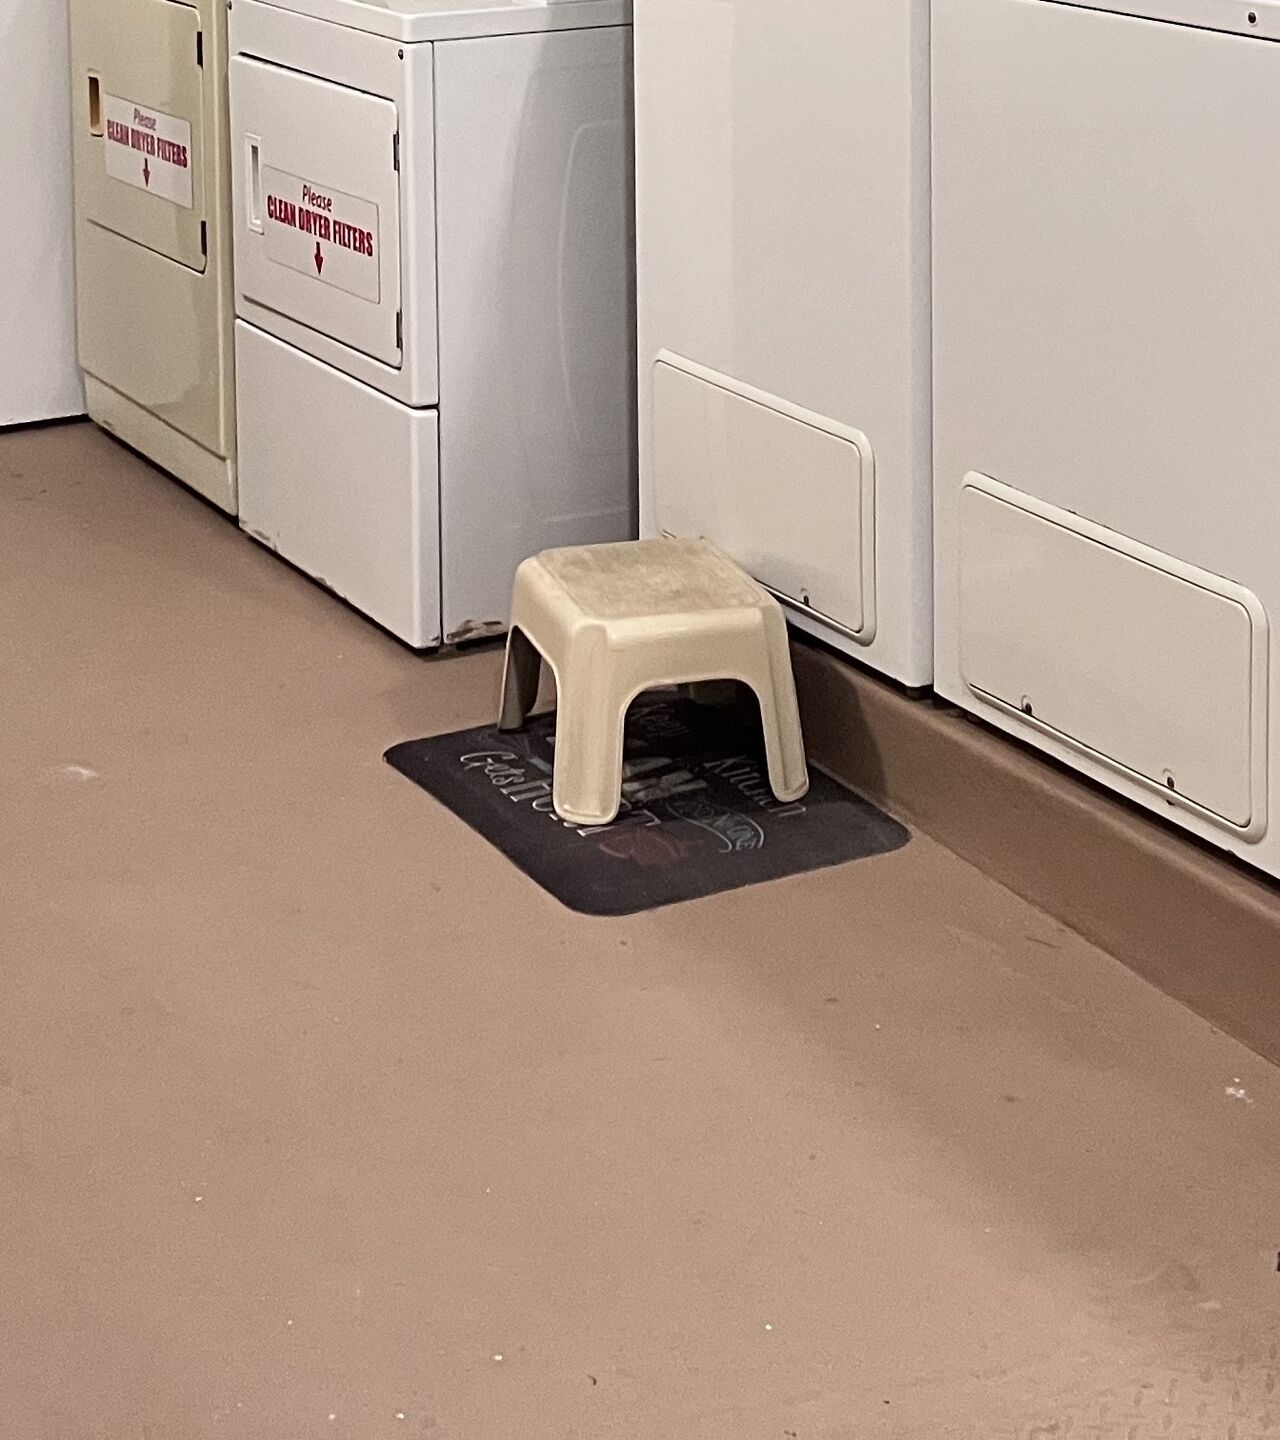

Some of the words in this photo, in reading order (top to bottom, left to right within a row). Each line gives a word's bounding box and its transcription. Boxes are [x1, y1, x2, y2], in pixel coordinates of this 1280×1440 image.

[133, 107, 157, 132] Please
[107, 119, 130, 146] CLEAN
[131, 128, 155, 157] DRYER
[157, 137, 188, 168] FILTERS
[302, 184, 332, 213] Please
[267, 195, 296, 228] CLEAN
[298, 206, 331, 241] DRYER
[333, 219, 373, 257] FILTERS
[460, 751, 525, 785] Gets
